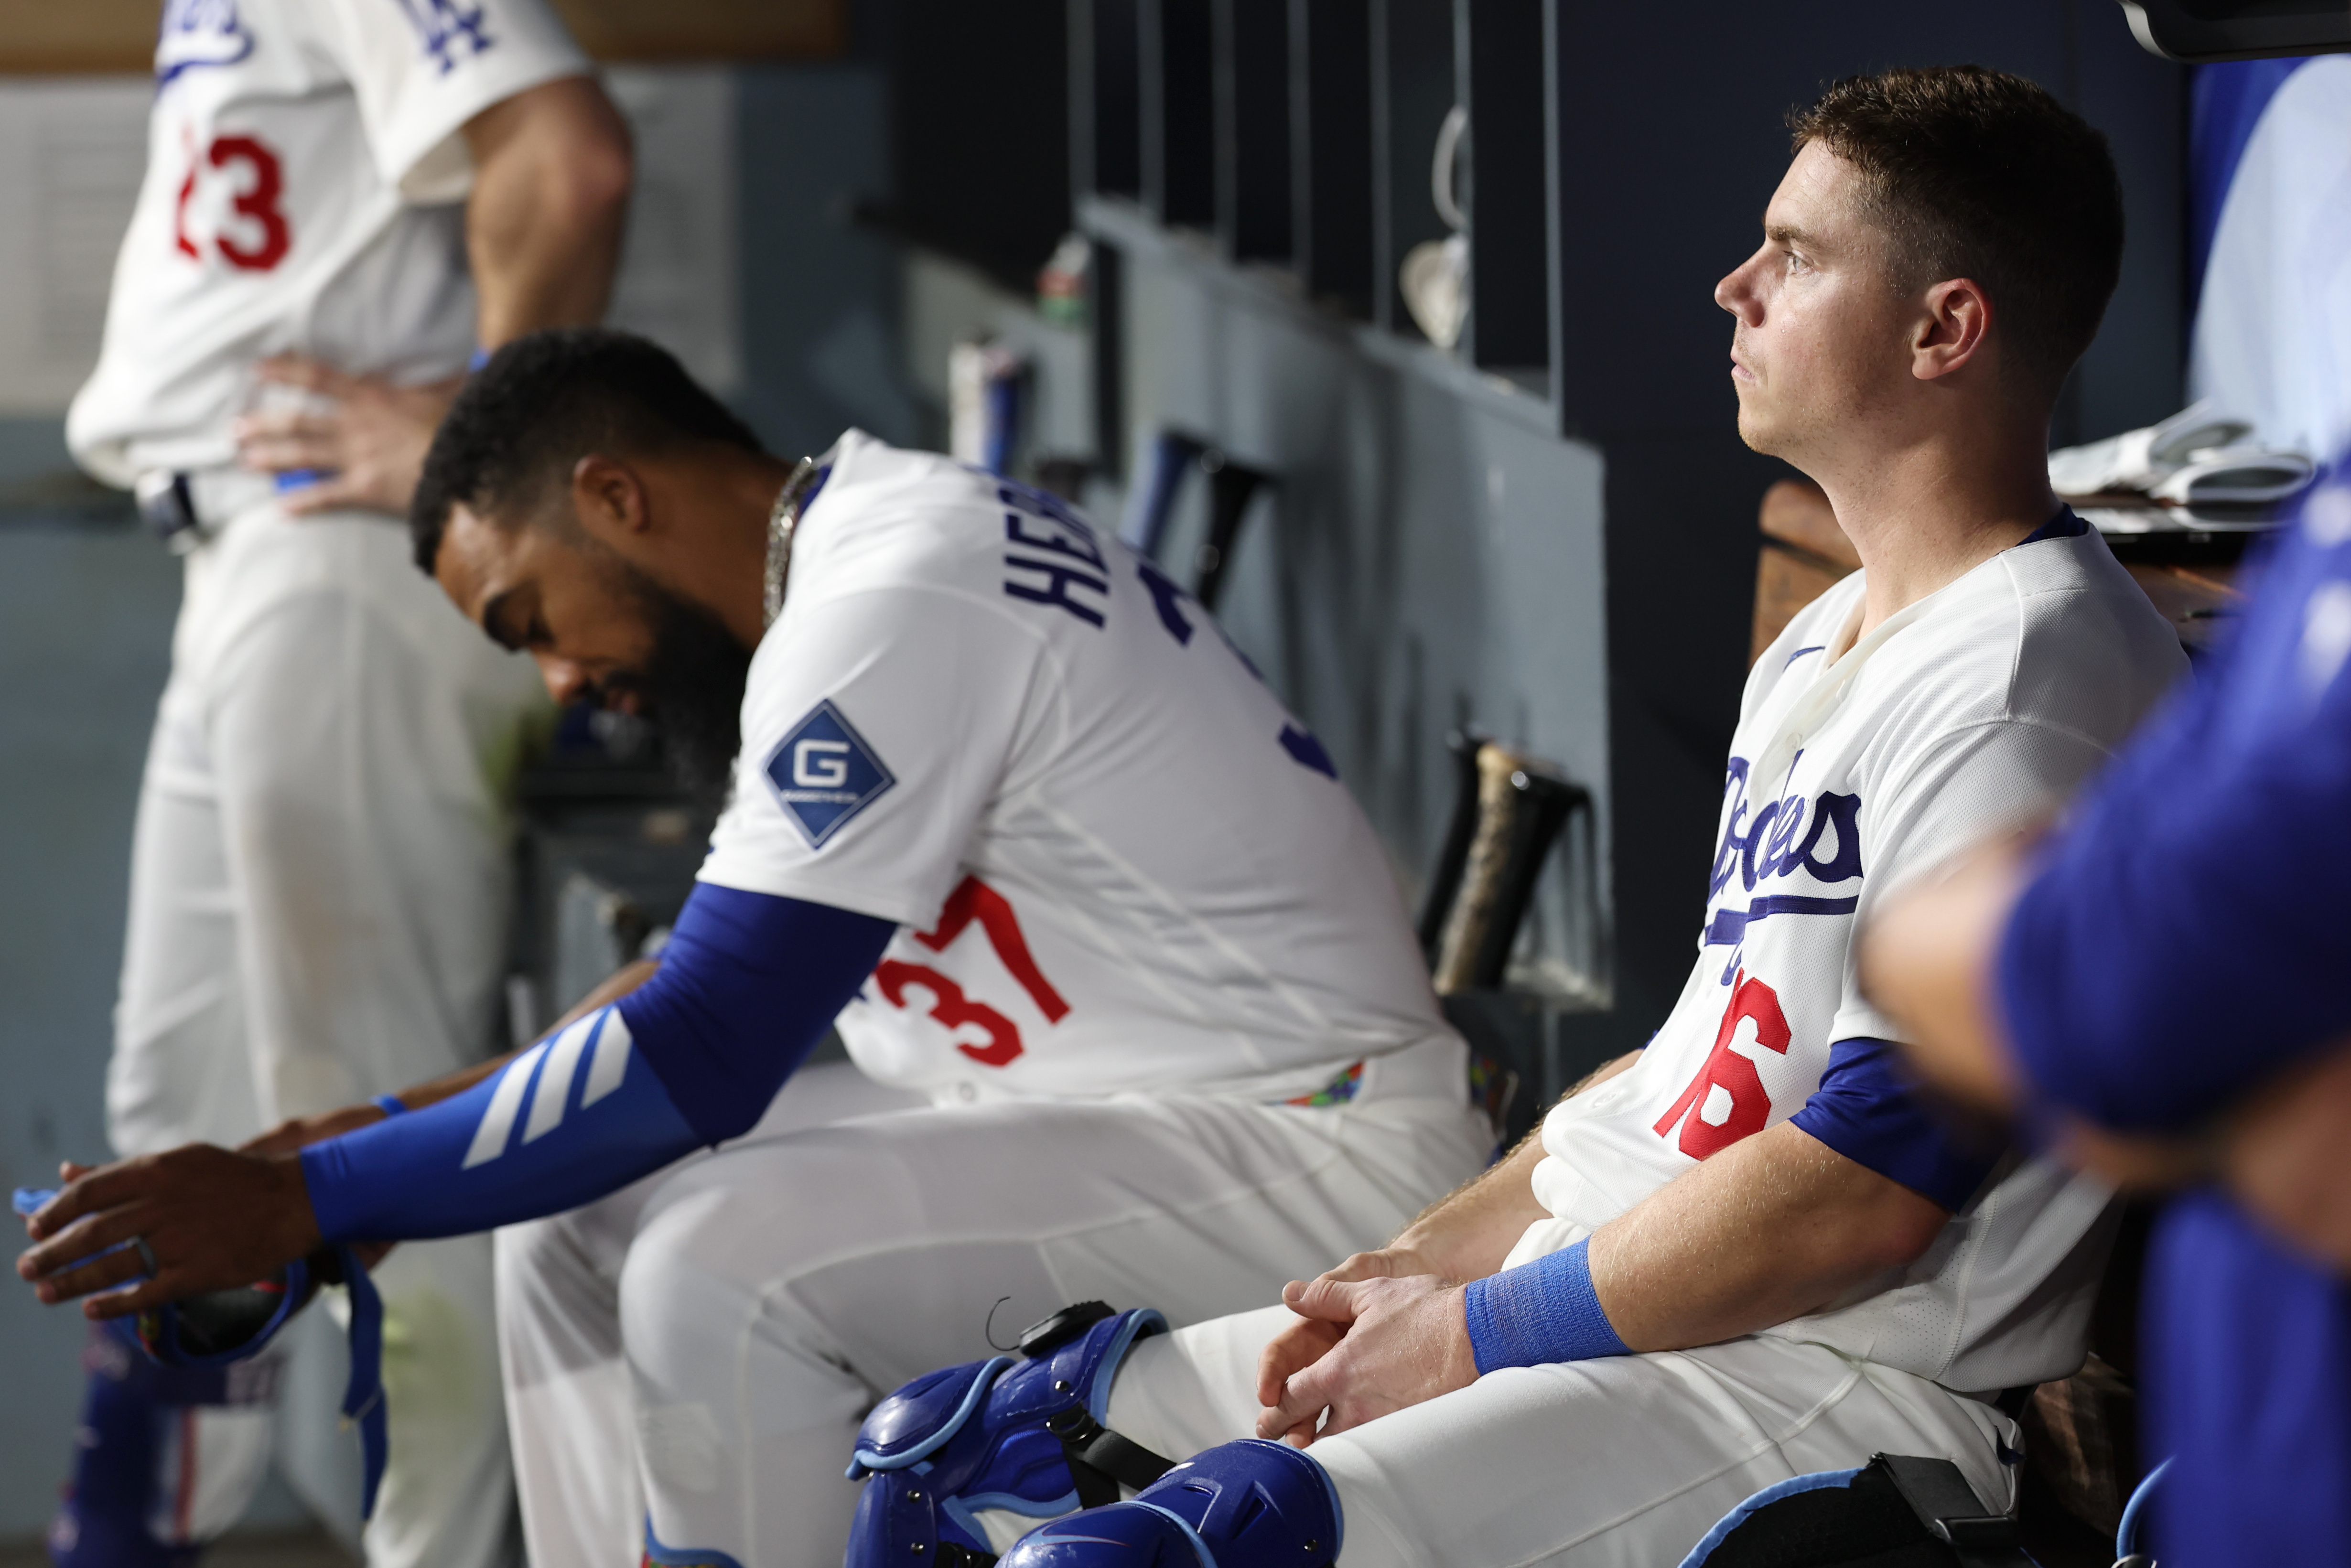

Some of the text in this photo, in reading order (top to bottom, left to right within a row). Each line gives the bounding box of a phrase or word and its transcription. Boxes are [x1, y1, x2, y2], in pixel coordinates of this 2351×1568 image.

[793, 739, 850, 787] G
[1706, 748, 1865, 986] Doders
[873, 873, 1071, 1068] 37
[1653, 968, 1792, 1161] 16
